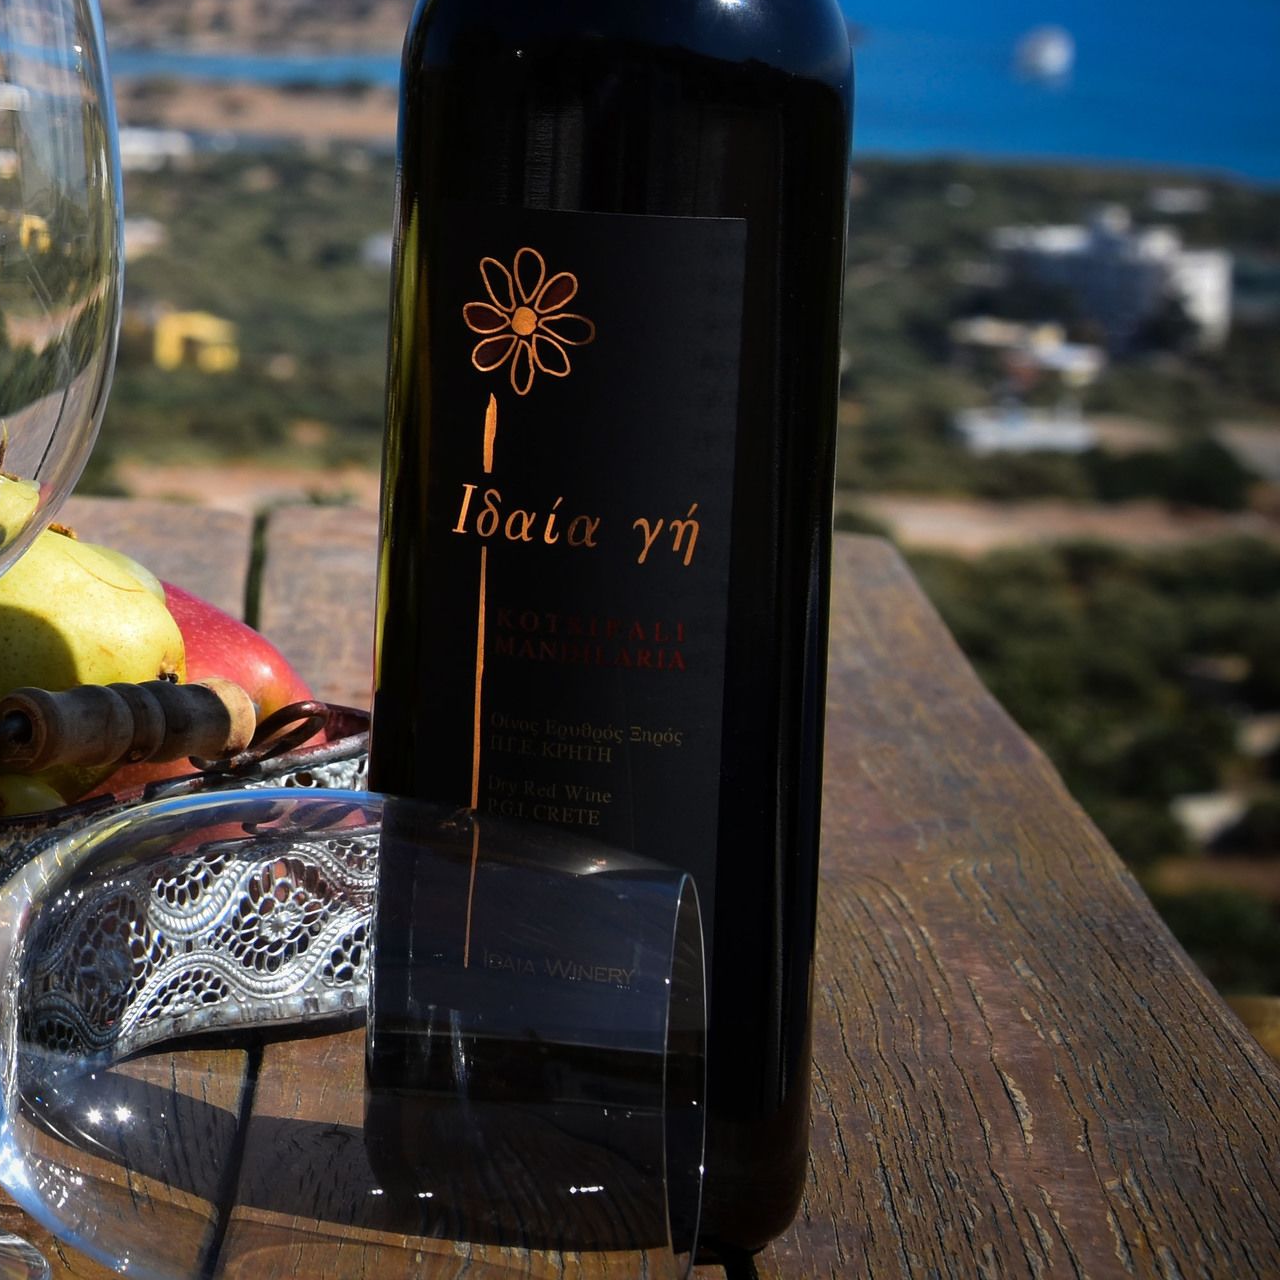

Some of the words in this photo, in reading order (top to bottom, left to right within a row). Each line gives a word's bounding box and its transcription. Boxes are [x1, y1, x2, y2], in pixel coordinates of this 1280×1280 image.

[451, 482, 601, 548] Ιδαία
[632, 502, 701, 567] γή
[495, 637, 687, 672] MANDILARIA
[629, 725, 684, 747] Ξηρός
[542, 741, 613, 763] ΚΡΗΤΗ
[488, 775, 518, 796] Dry
[524, 780, 557, 800] Red
[564, 784, 612, 804] Wine
[533, 804, 600, 826] CRETE
